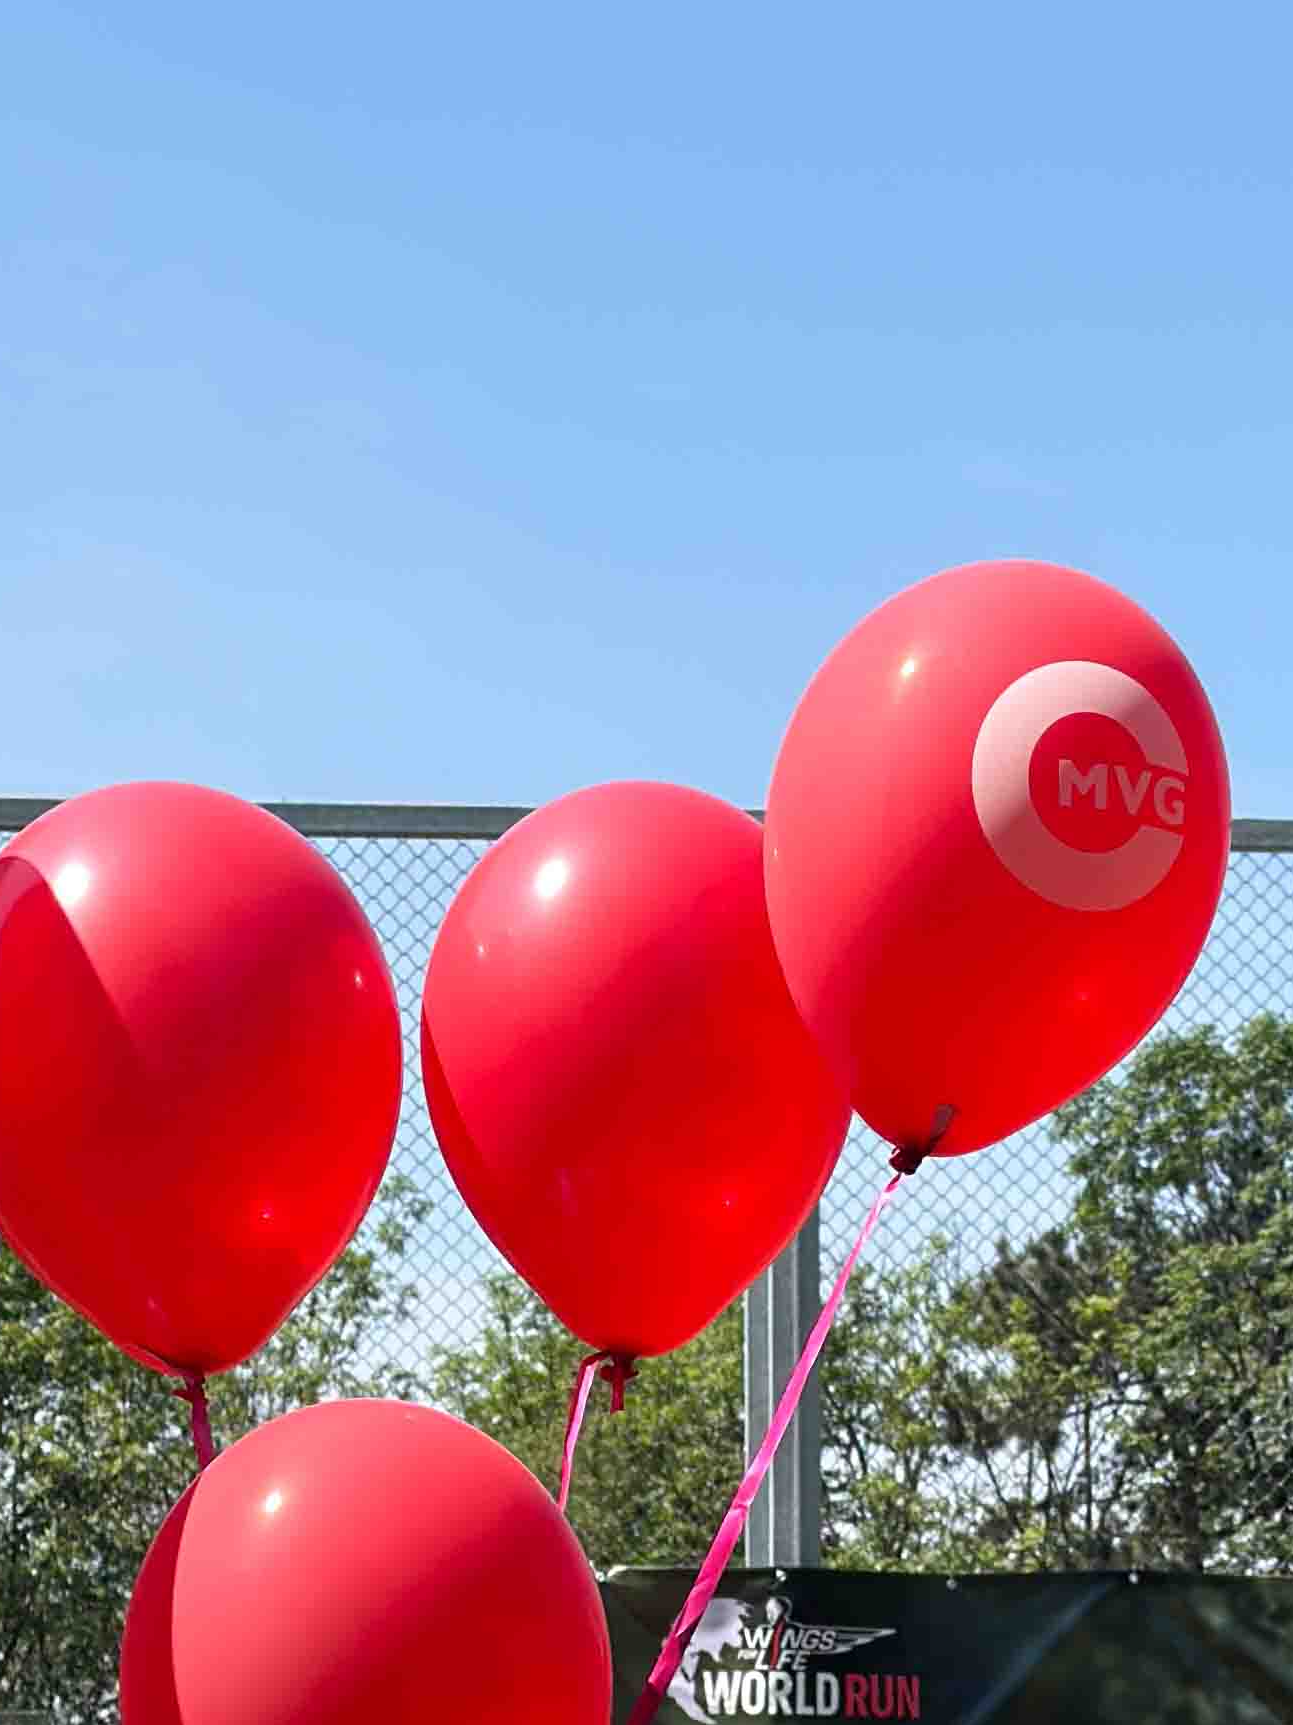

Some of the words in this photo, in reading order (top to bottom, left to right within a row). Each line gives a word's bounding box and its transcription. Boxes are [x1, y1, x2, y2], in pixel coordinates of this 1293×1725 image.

[1057, 758, 1186, 826] MVG
[742, 1628, 837, 1651] WINGS
[754, 1649, 811, 1671] LIFE
[703, 1671, 840, 1716] WORLD
[844, 1674, 921, 1720] RUN
